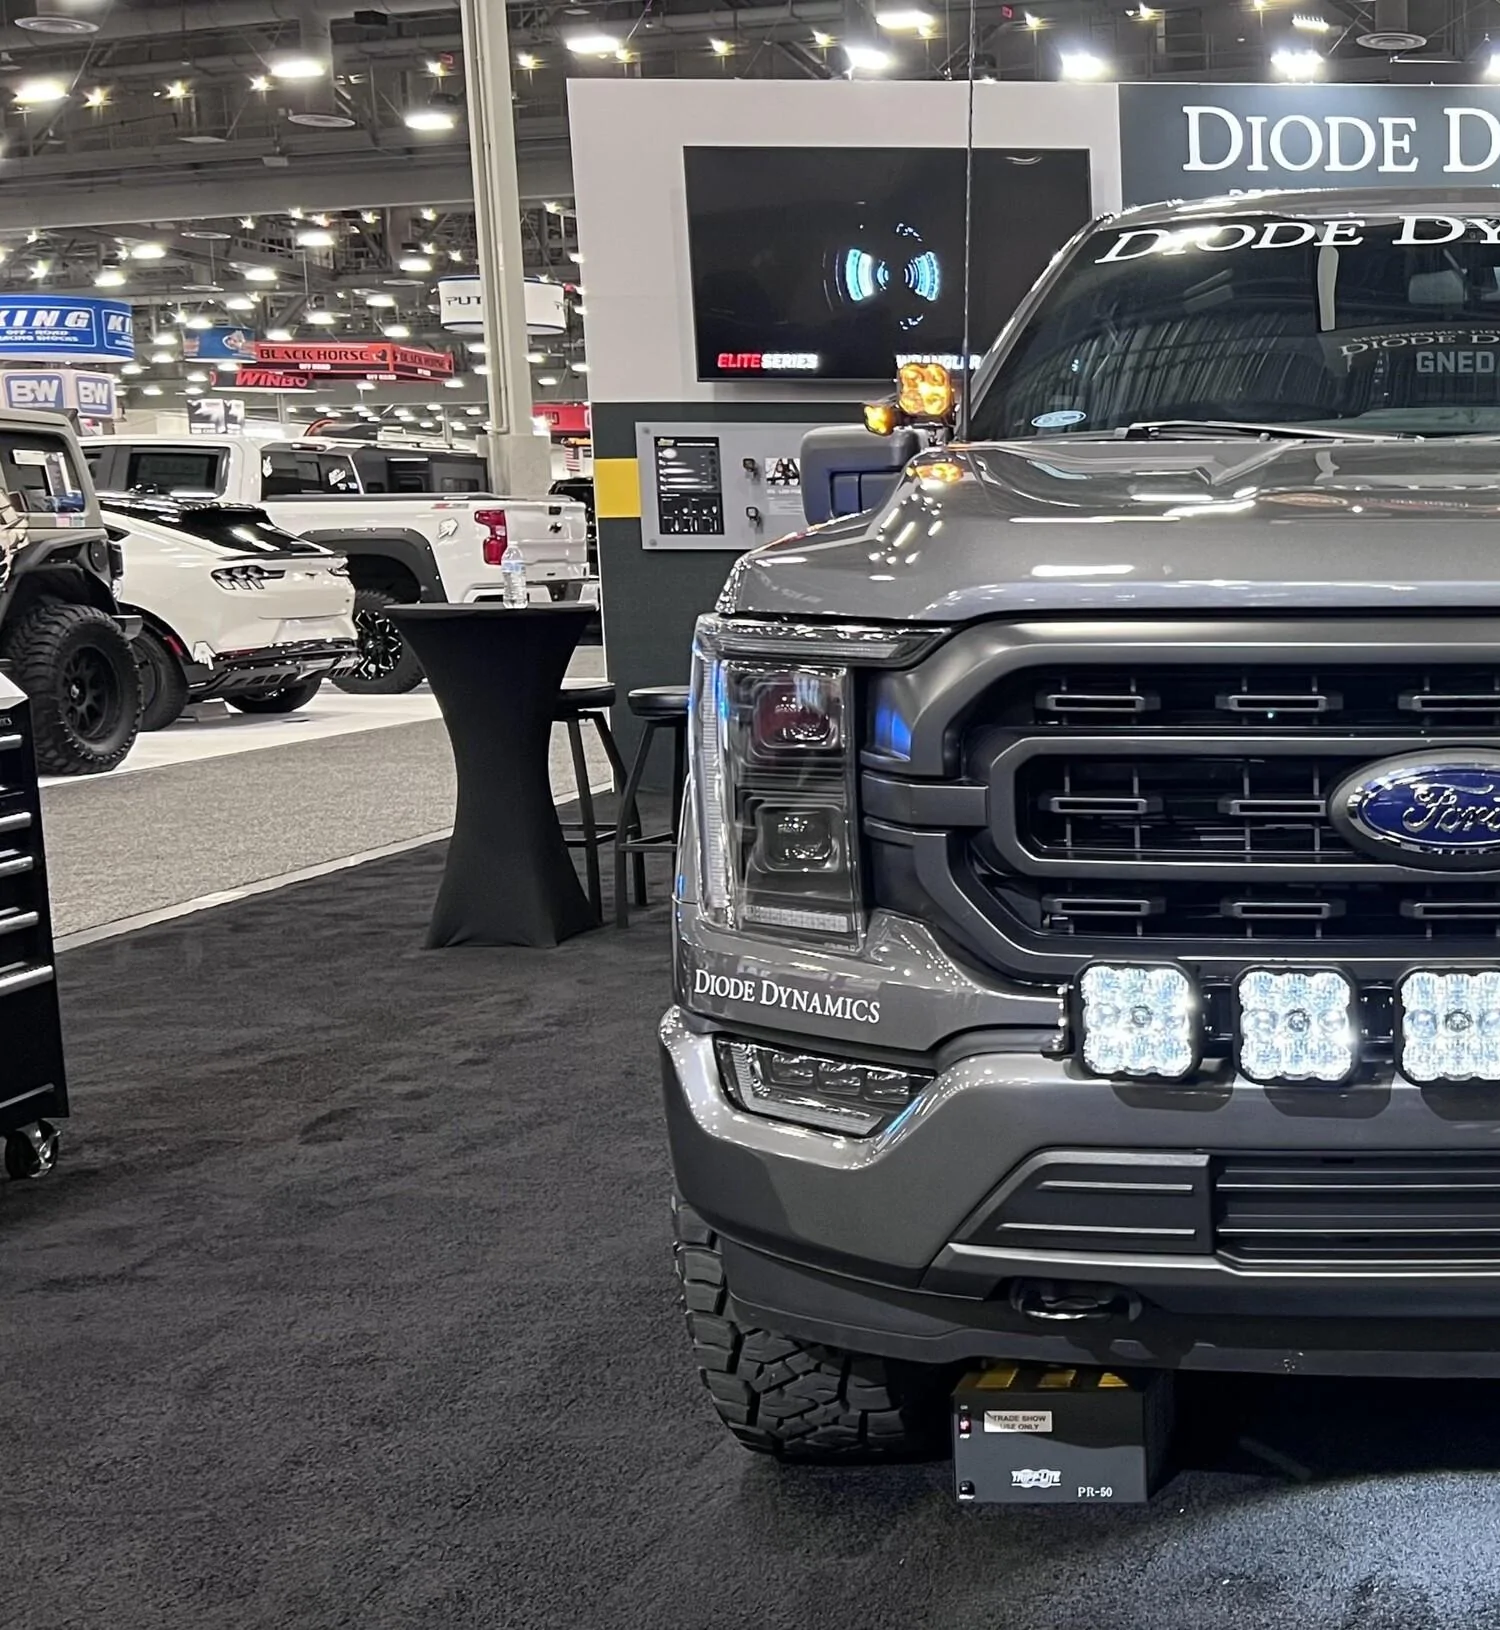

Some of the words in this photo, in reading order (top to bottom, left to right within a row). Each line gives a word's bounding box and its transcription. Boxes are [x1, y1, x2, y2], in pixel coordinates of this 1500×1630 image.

[1182, 106, 1419, 173] DIODE
[260, 348, 313, 359] BLACK
[317, 350, 369, 361] HORSE
[896, 354, 981, 369] WRANGLR
[694, 969, 756, 1002] DIODE
[759, 980, 881, 1024] DYNAMICS
